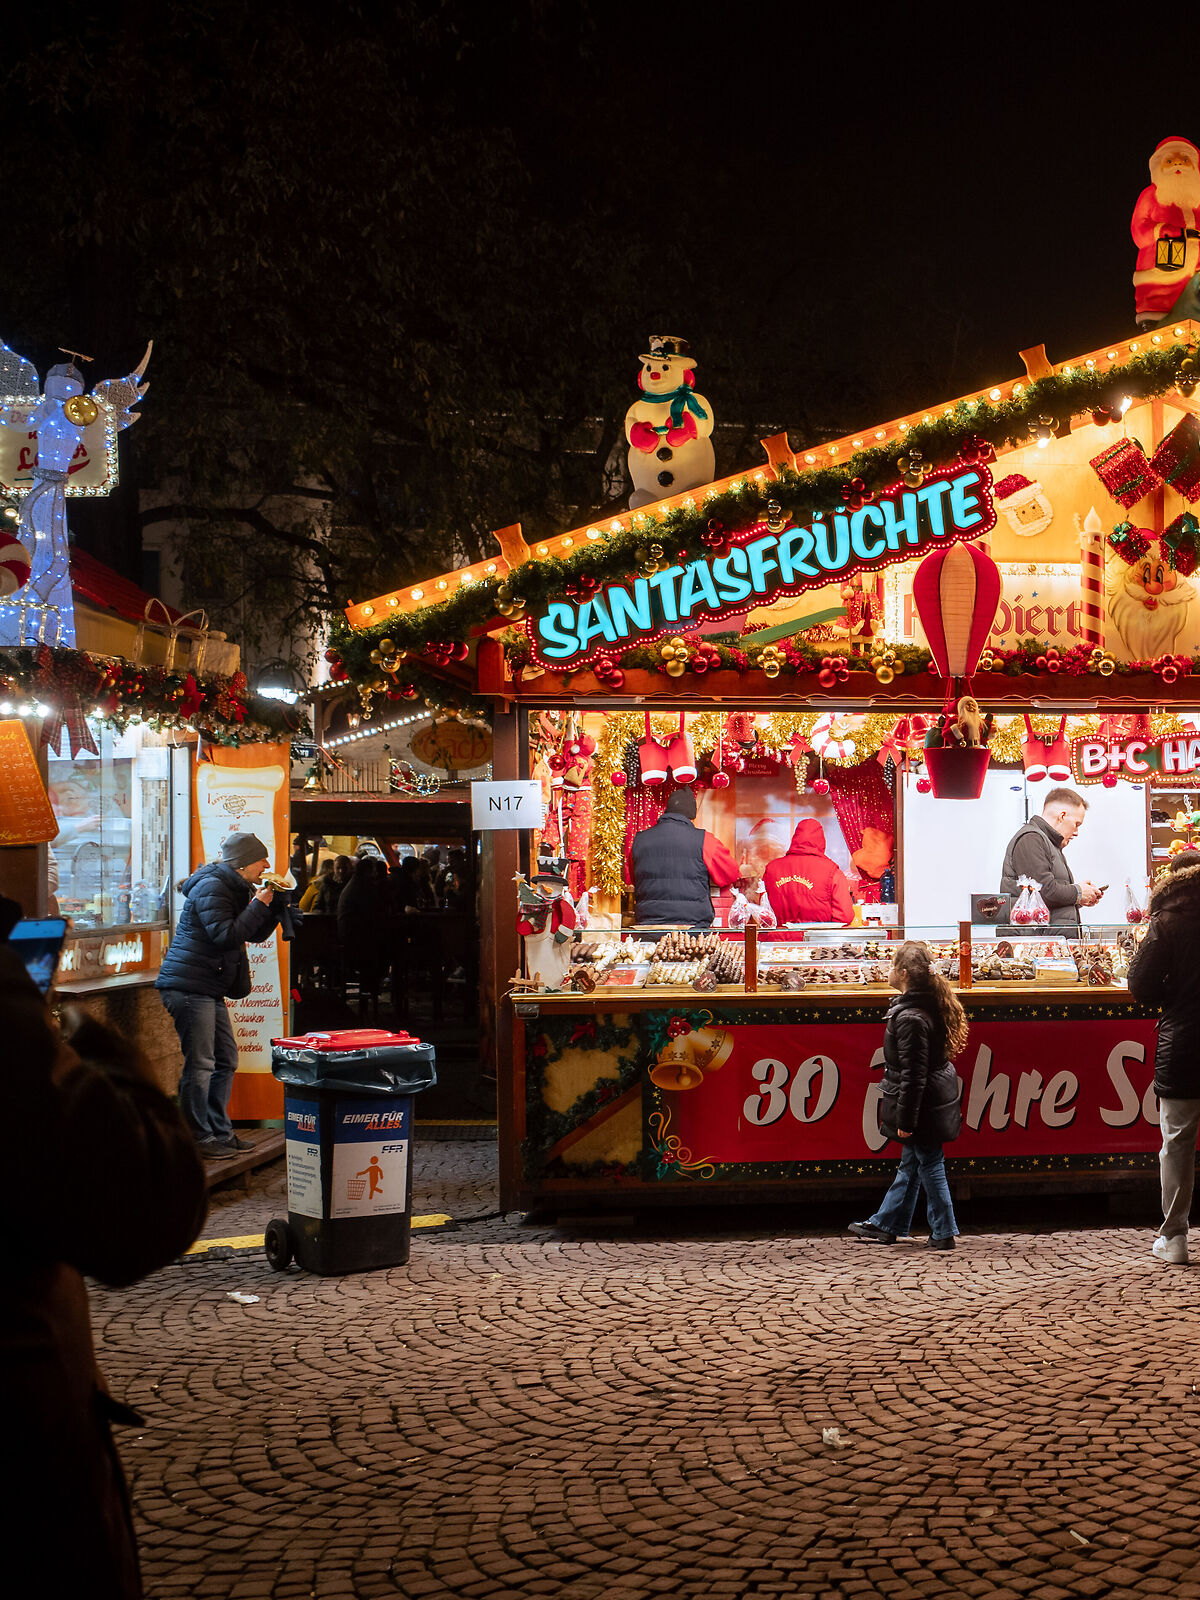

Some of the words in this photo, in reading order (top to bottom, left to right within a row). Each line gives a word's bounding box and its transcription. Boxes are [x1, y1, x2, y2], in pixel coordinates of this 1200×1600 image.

[539, 472, 982, 658] SANTASFRÜCHTE
[489, 796, 524, 812] N17
[233, 1012, 265, 1024] Schinken
[743, 1055, 839, 1126] 30
[287, 1111, 304, 1122] EIMER
[304, 1114, 317, 1125] FÜR
[343, 1112, 380, 1124] EIMER
[380, 1110, 404, 1122] FÜR
[364, 1119, 402, 1130] ALLES.
